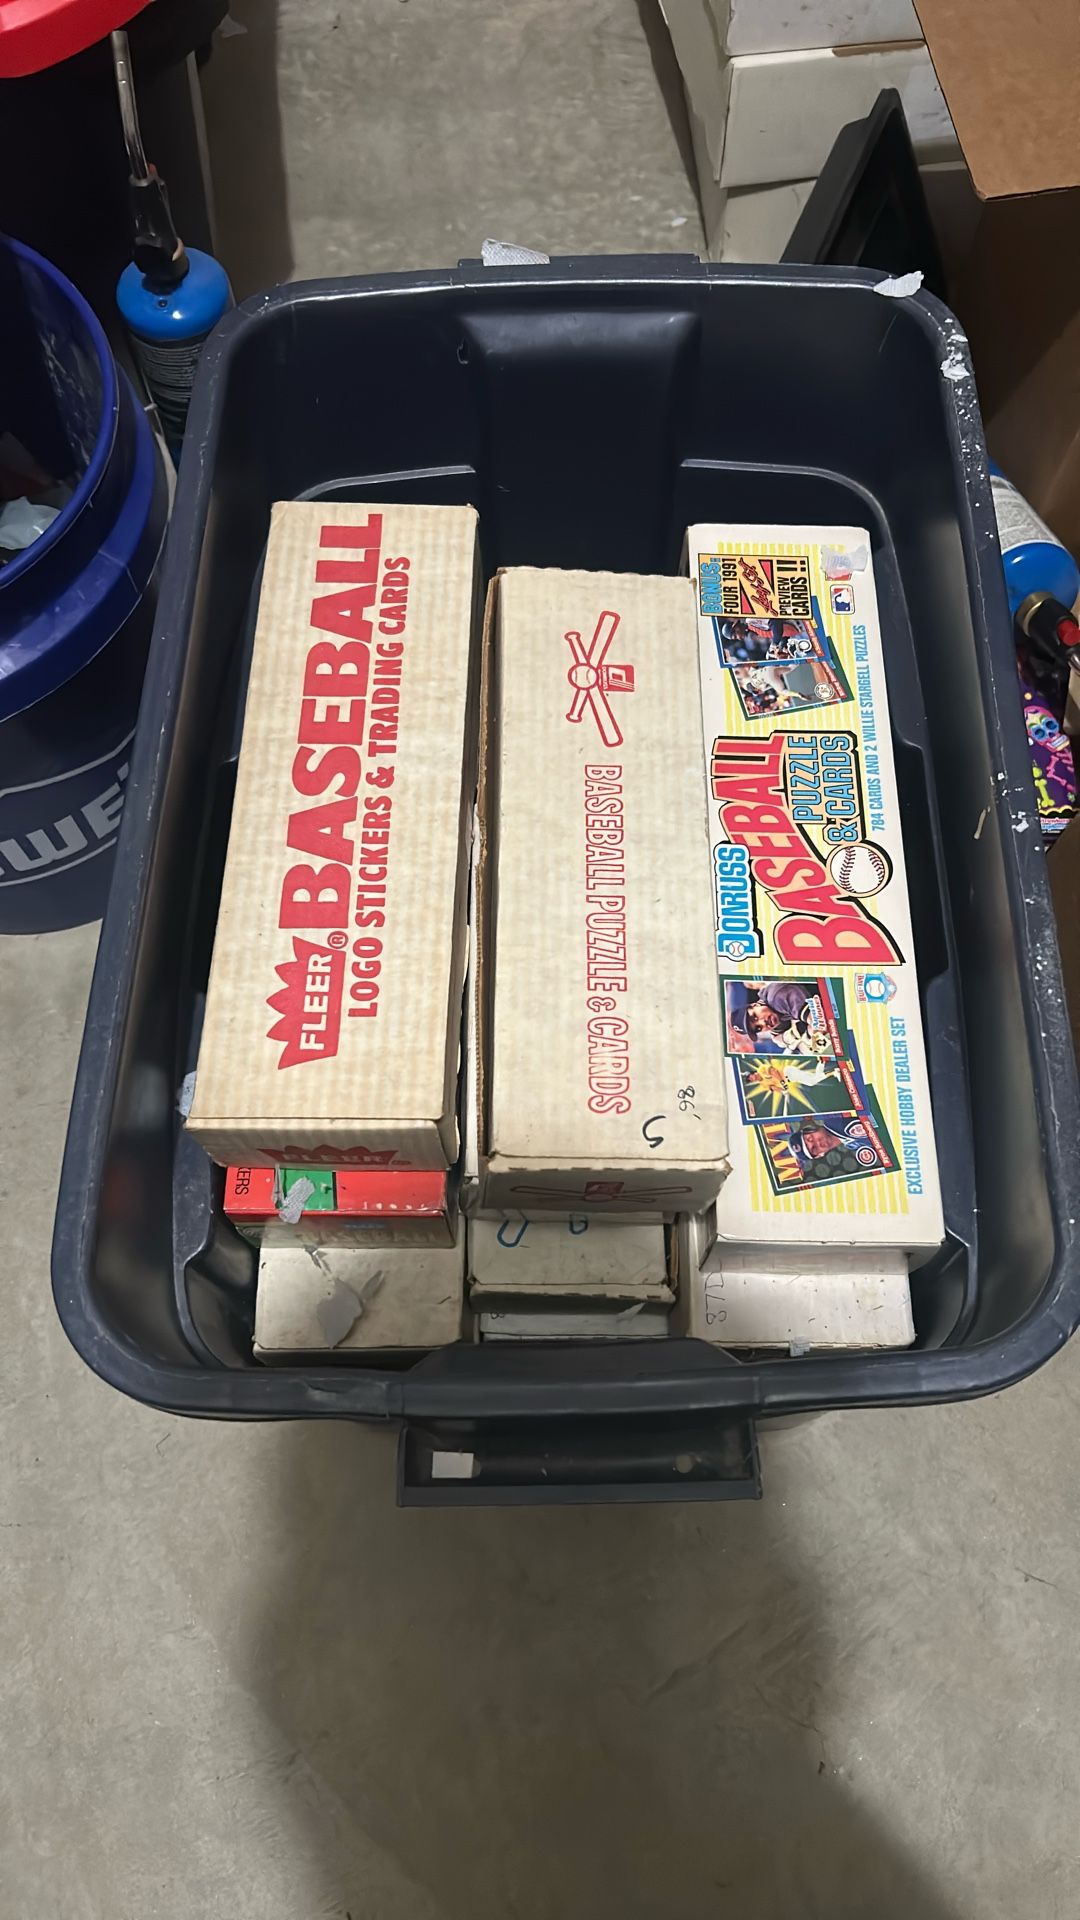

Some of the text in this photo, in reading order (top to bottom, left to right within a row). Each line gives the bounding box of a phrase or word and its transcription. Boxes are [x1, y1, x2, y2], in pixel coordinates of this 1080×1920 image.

[700, 556, 723, 615] BONUS:
[721, 557, 739, 615] FOUR 1991
[777, 576, 792, 616] PREVIEW
[790, 577, 810, 616] CARDS
[854, 625, 868, 663] PUZZLES
[858, 664, 873, 708] STARGELL
[278, 513, 383, 929] BASEBALL
[861, 709, 877, 742] WILLIE
[348, 556, 411, 1018] LOGO STICKERS & TRADING CARDS
[787, 735, 824, 821] PUZZLE
[819, 735, 856, 816] CARDS
[865, 754, 880, 775] AND
[866, 776, 885, 810] CARDS
[713, 733, 897, 964] BASEBALL
[826, 821, 859, 842] &
[872, 813, 885, 831] 784
[717, 846, 756, 954] DONRUSS
[584, 764, 632, 1115] BASEBALL PUZZLE & CARDS
[300, 953, 332, 1051] FLEER
[892, 1016, 923, 1195] EXCLUSIVE HOBBY DEALER SET
